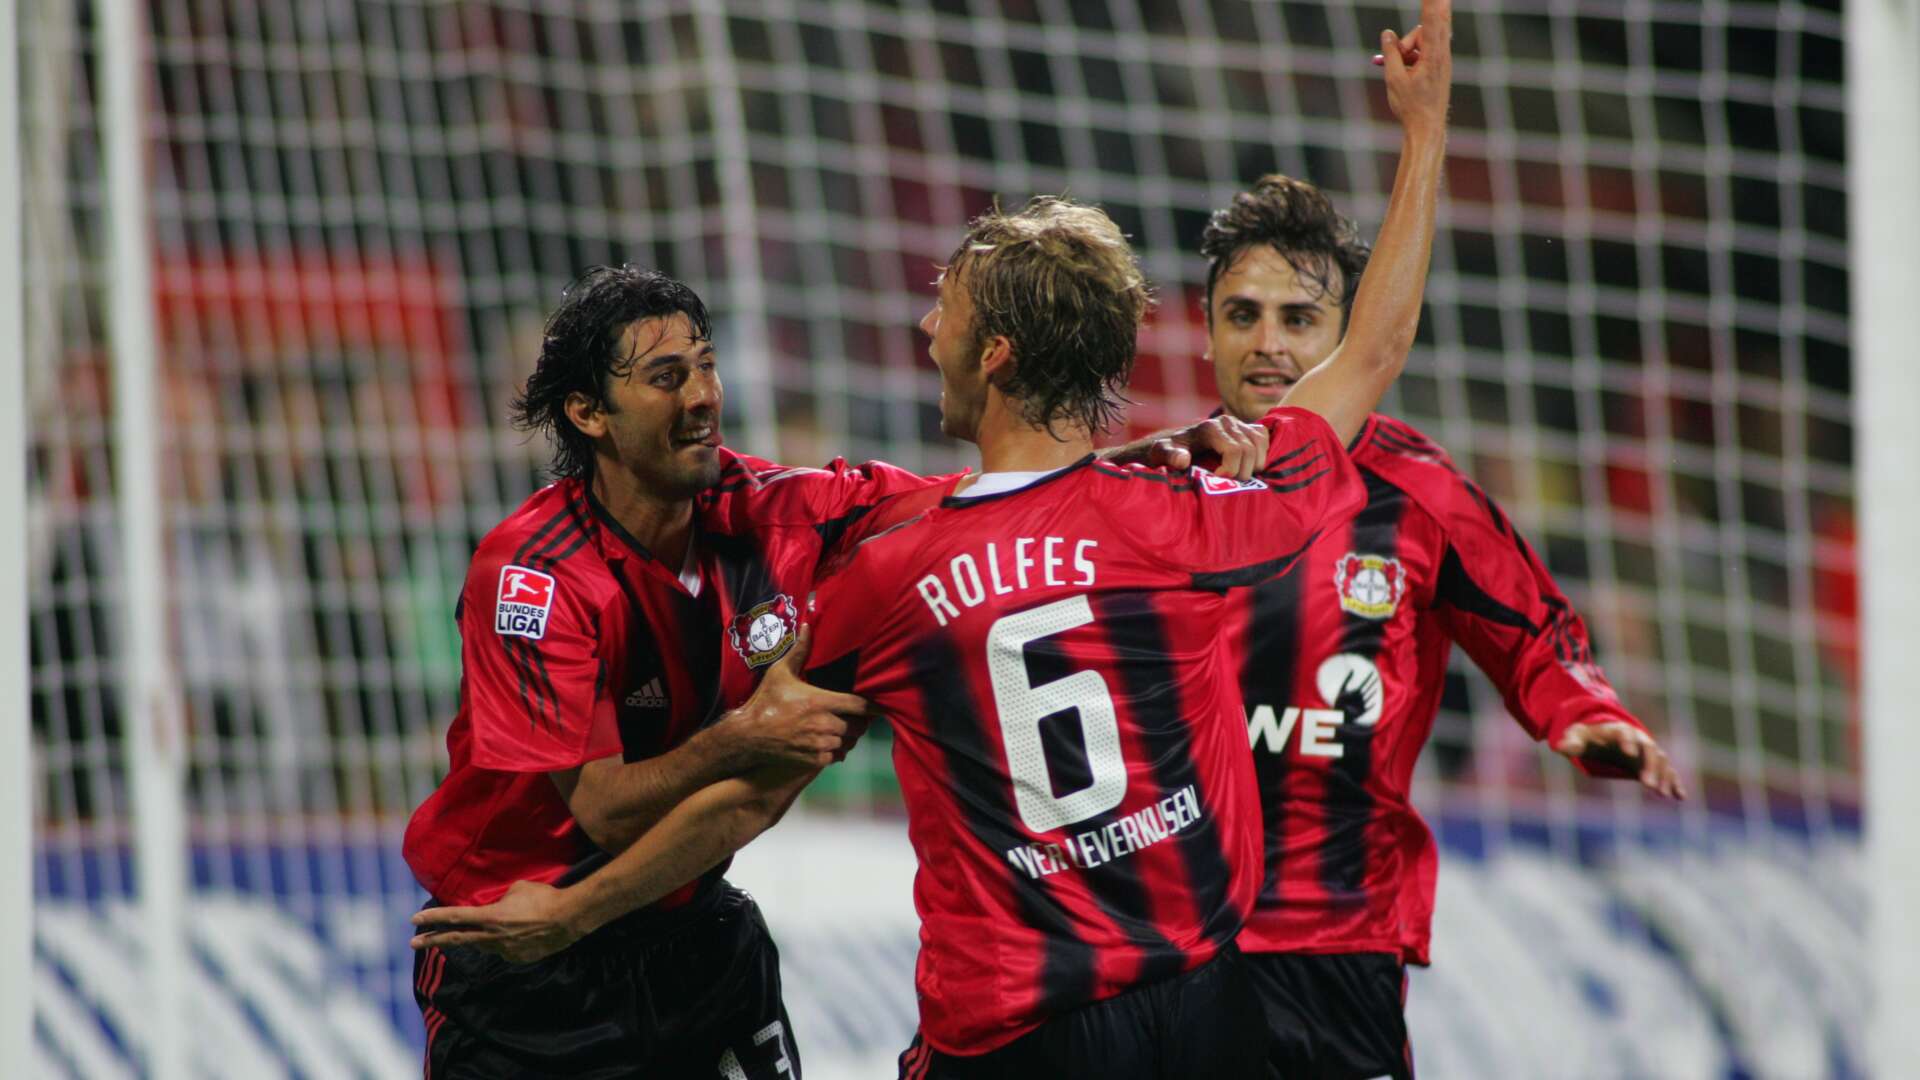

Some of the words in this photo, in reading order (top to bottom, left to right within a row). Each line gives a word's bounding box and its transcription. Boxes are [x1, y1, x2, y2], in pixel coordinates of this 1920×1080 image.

[499, 603, 545, 618] BUNDES
[916, 536, 1098, 627] ROLFES
[498, 613, 542, 636] LIGA
[986, 593, 1128, 833] 6
[1065, 784, 1201, 869] LEVERKUSEN
